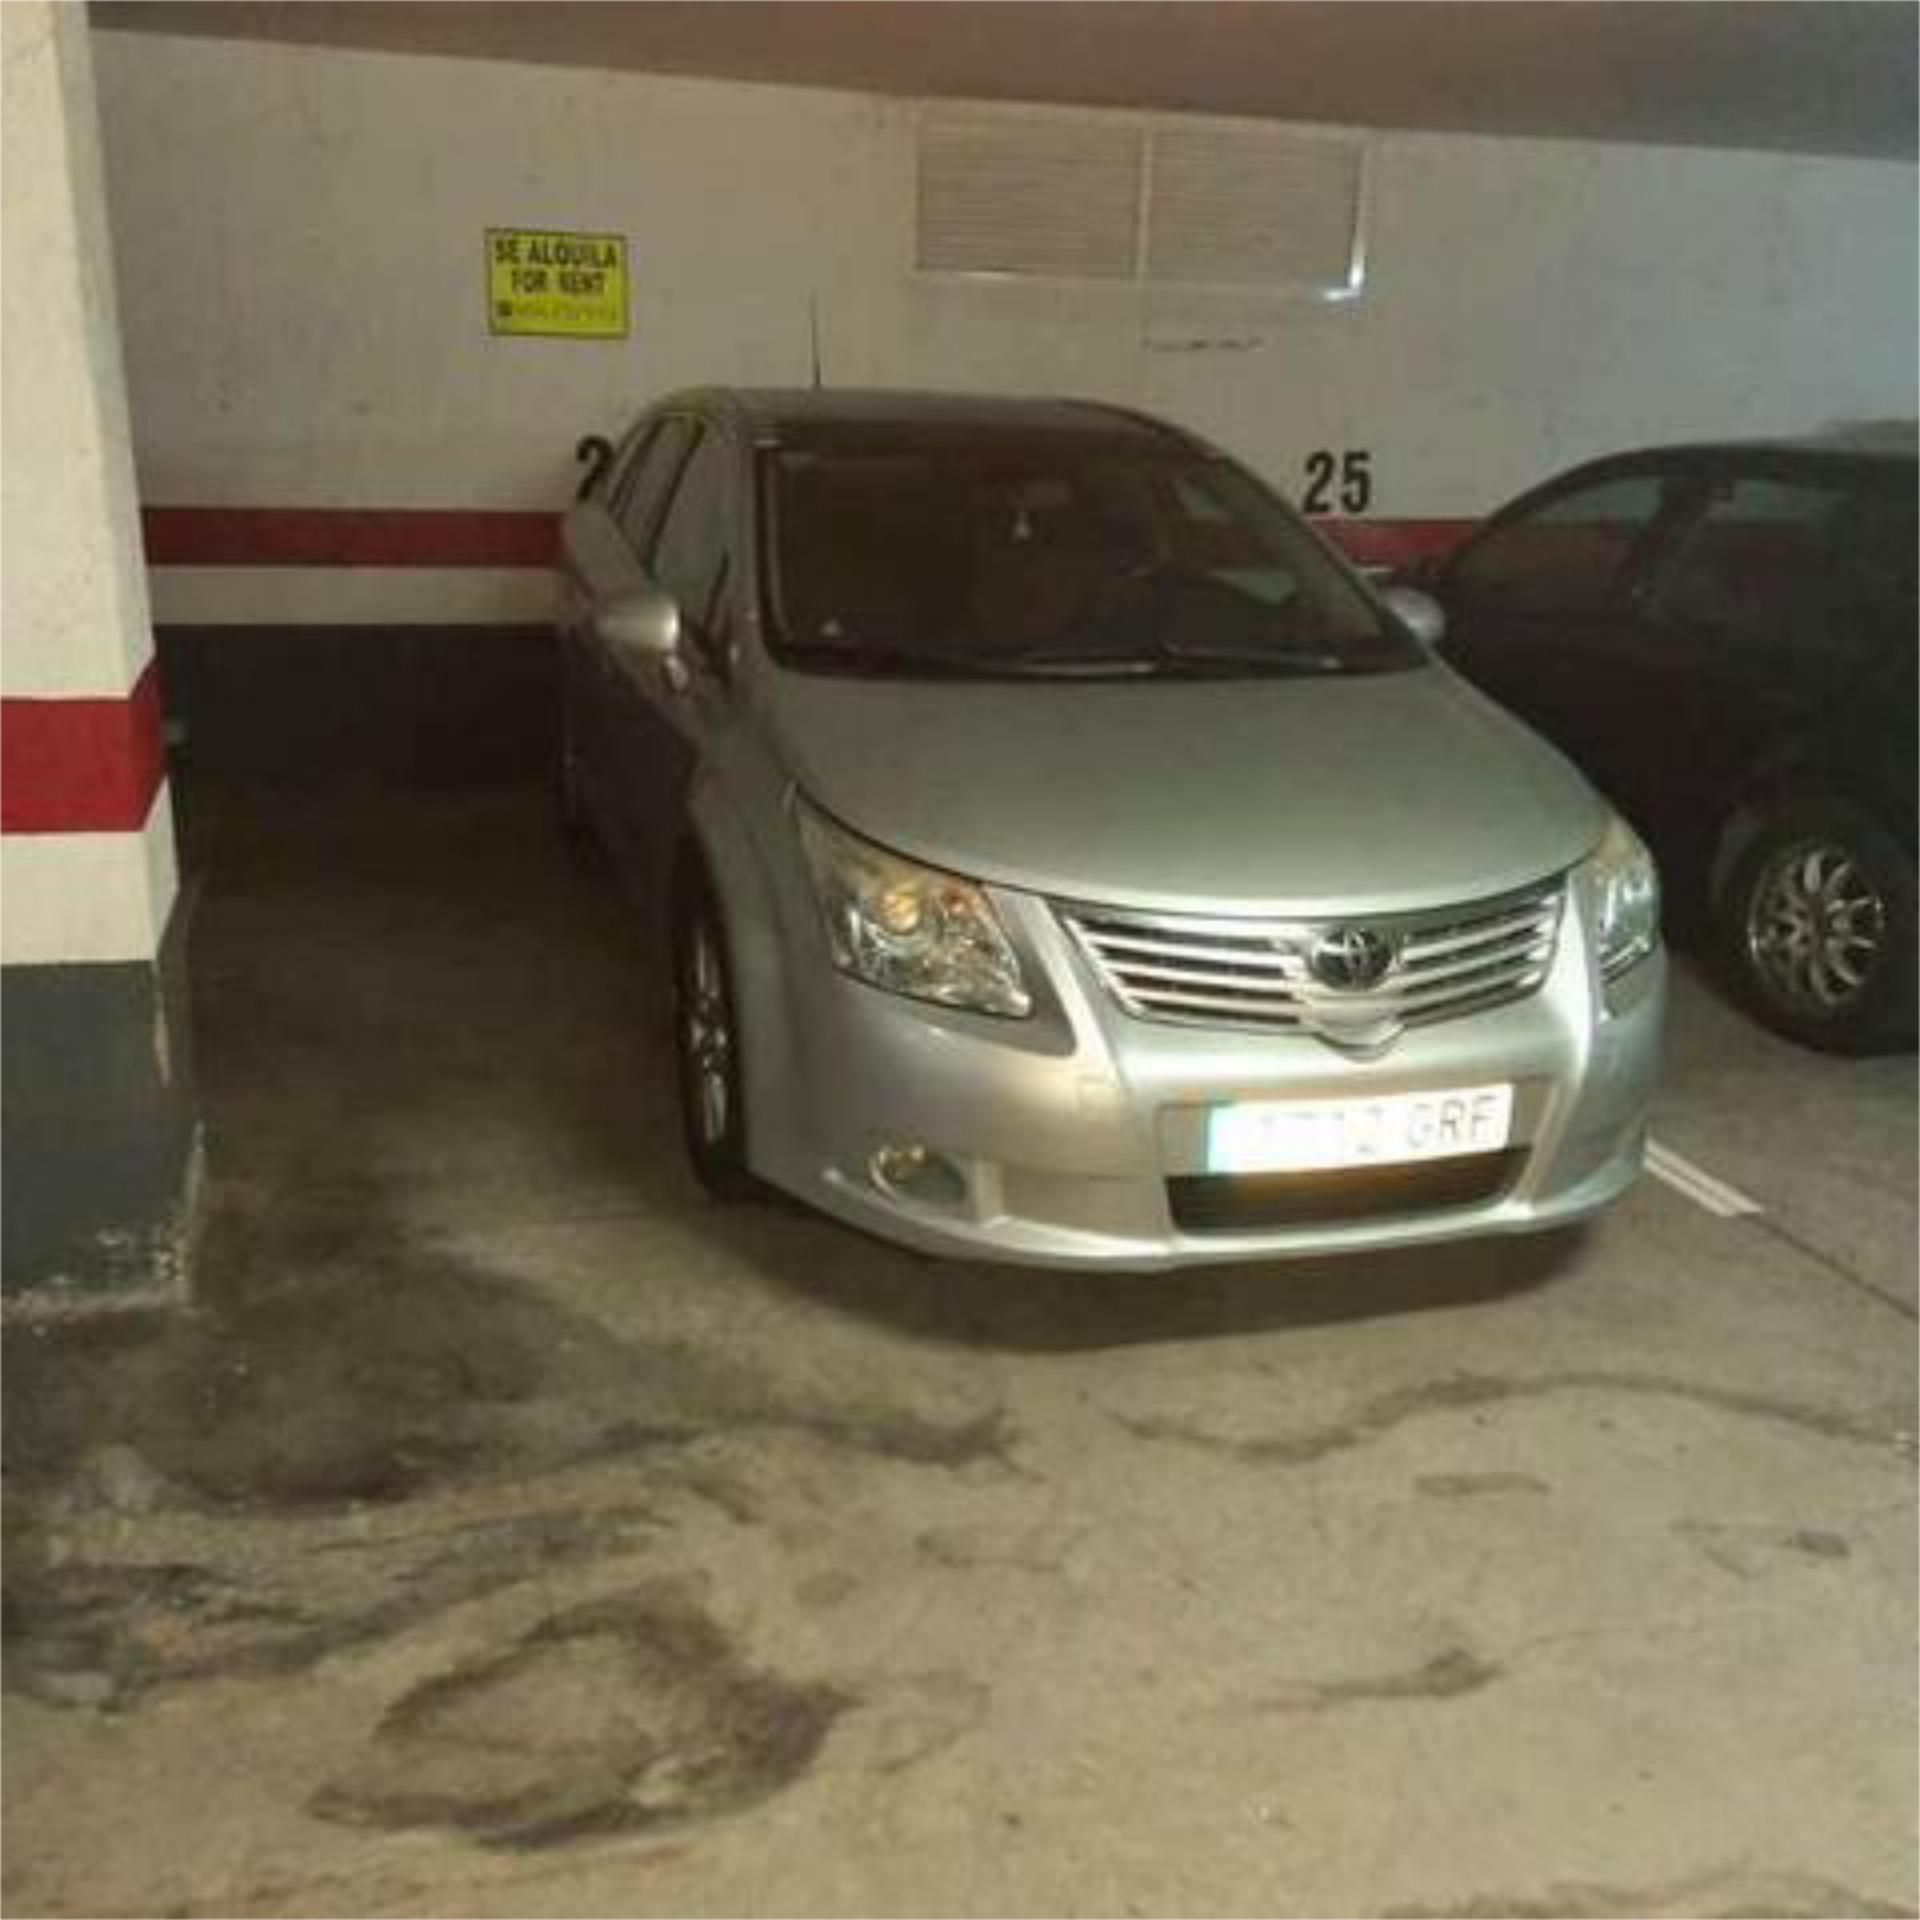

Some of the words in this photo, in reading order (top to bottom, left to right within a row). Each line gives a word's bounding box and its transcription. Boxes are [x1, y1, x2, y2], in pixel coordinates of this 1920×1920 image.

[496, 239, 520, 263] SE
[527, 240, 617, 268] ALQUILA
[511, 269, 546, 293] FOR
[559, 271, 605, 296] RENT
[576, 436, 613, 500] 2
[1303, 451, 1371, 513] 25
